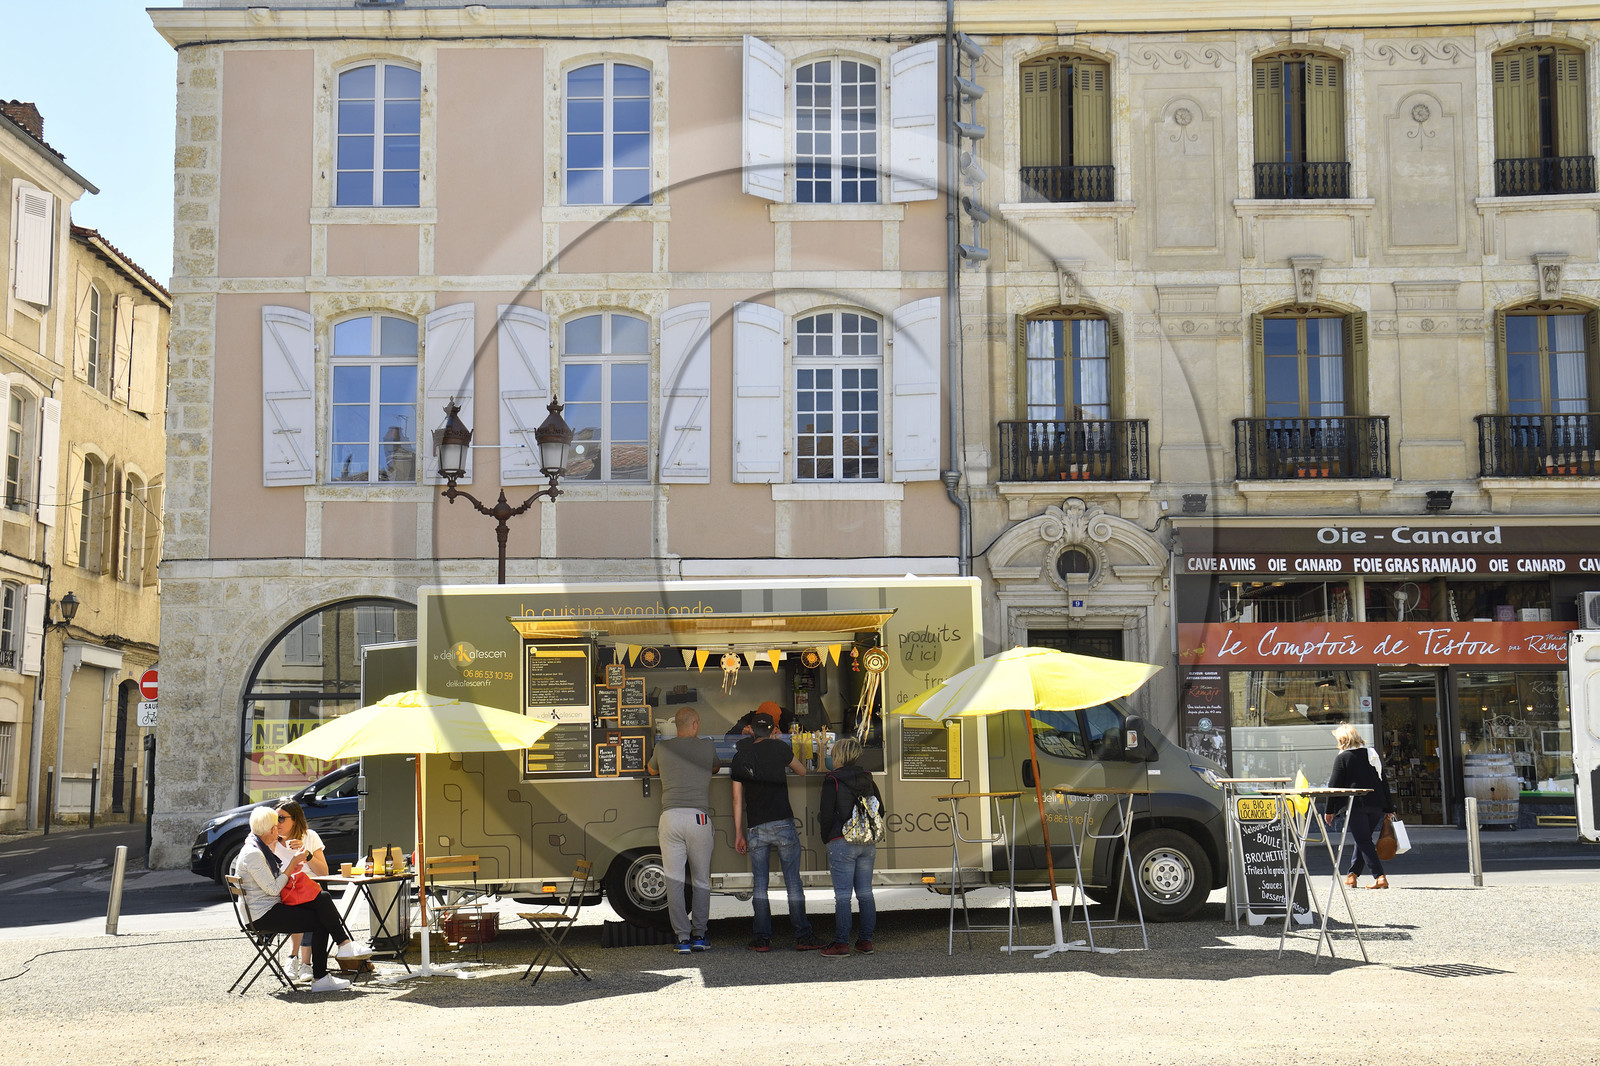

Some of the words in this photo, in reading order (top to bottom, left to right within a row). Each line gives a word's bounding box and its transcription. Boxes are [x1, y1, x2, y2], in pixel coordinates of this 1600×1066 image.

[1316, 527, 1367, 544] Oie
[1391, 525, 1502, 544] Canard
[1187, 557, 1218, 571] CAVE
[1219, 557, 1228, 571] A
[1229, 557, 1257, 571] VINS
[1267, 558, 1287, 572] OIE
[1294, 558, 1342, 572] CANARD
[1353, 557, 1383, 573] FOIE
[1384, 557, 1420, 573] GRAS
[1421, 557, 1477, 573] RAMAJO
[1489, 558, 1509, 572] OIE
[1516, 558, 1566, 572] CANARD
[1579, 558, 1600, 571] CAV
[541, 604, 604, 616] cuisine
[898, 624, 961, 648] produits
[1217, 629, 1248, 658] Le
[1257, 626, 1364, 662] Comptoir
[1372, 634, 1409, 656] de
[1417, 628, 1501, 656] Tistou
[905, 643, 936, 661] d'ici
[1524, 635, 1567, 661] Rama
[463, 669, 474, 678] 06
[475, 670, 484, 678] 86
[484, 670, 494, 679] 53
[495, 671, 503, 680] 10
[504, 671, 514, 681] 59
[925, 672, 948, 690] fra
[896, 690, 909, 703] de
[256, 723, 304, 744] NEW
[267, 791, 297, 800] HOMM
[1240, 809, 1270, 818] LOCAVORE
[1253, 800, 1264, 810] BIO
[1256, 833, 1298, 854] BOULEES
